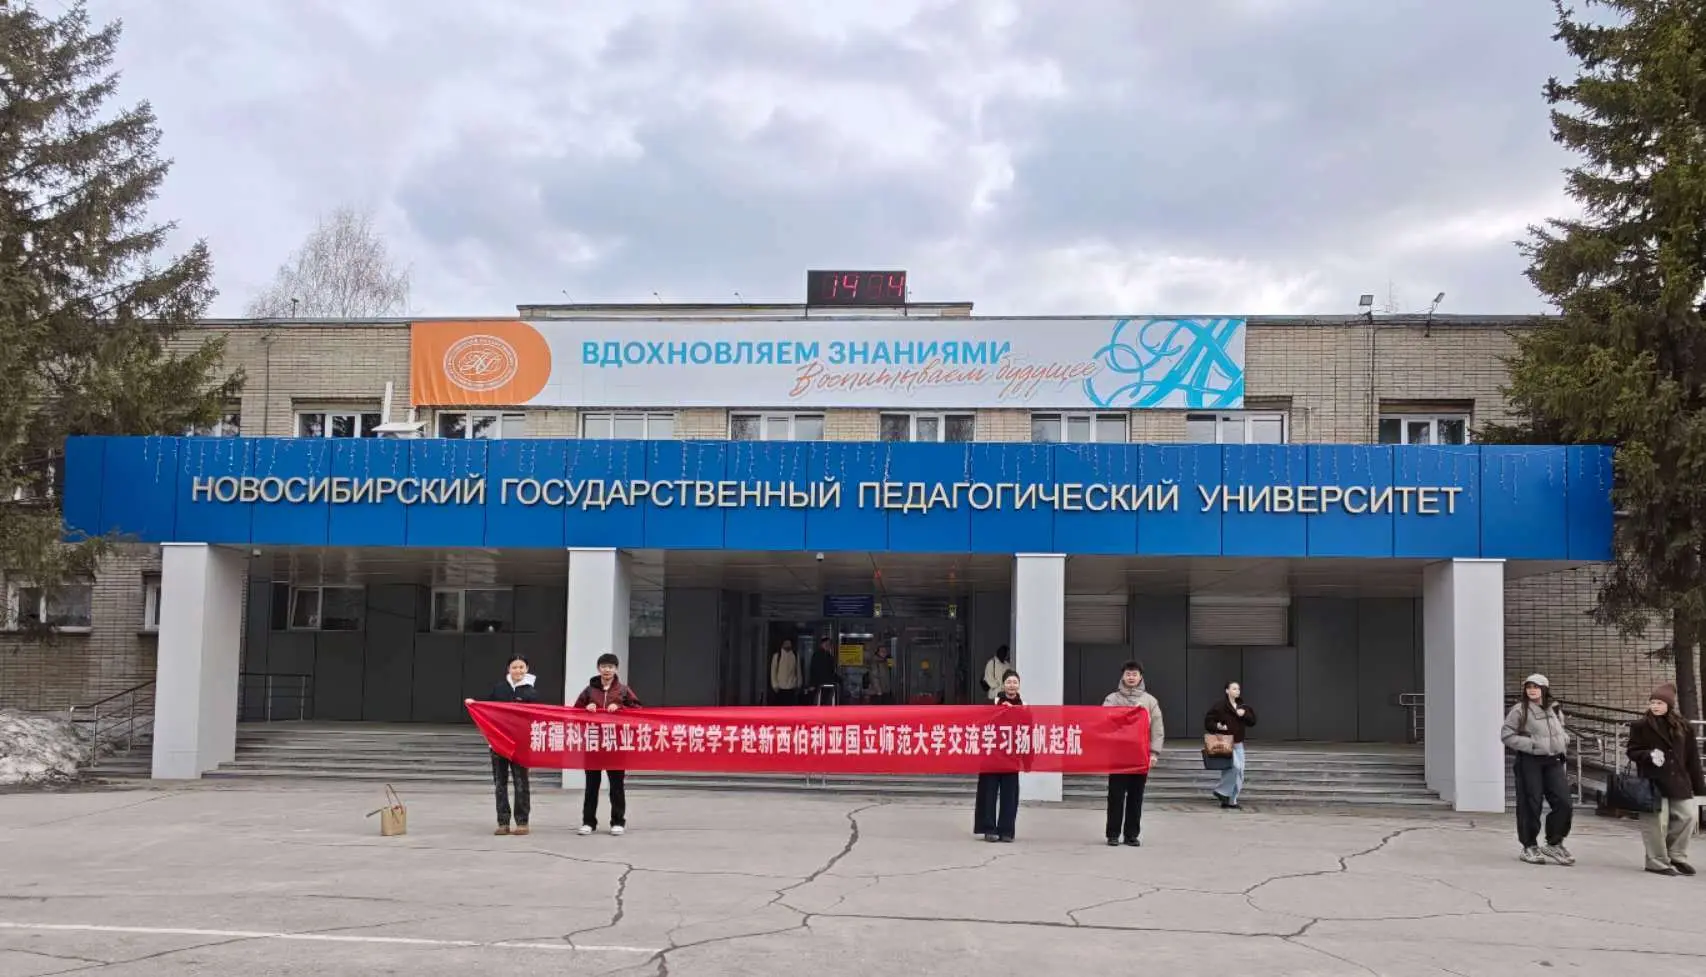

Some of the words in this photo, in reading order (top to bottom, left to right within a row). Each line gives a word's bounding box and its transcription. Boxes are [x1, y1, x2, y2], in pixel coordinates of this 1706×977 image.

[583, 341, 819, 367] ВДОХНОВЛЯЕМ
[829, 341, 1011, 365] ЗНАНИЯМИ
[788, 358, 989, 398] Воспитываем
[994, 355, 1099, 399] будущее
[192, 474, 485, 505] НОВОСИБИРСКИЙ
[501, 476, 841, 511] ГОСУДАРСТВЕННЫЙ
[859, 477, 1179, 514] ПЕДАГОГИЧЕСКИЙ
[1199, 485, 1462, 514] УНИВЕРСИТЕТ
[530, 720, 1083, 757] 新疆科信职业技术学院学子赴新西伯利亚国立师范大学交流学习扬帆起航
